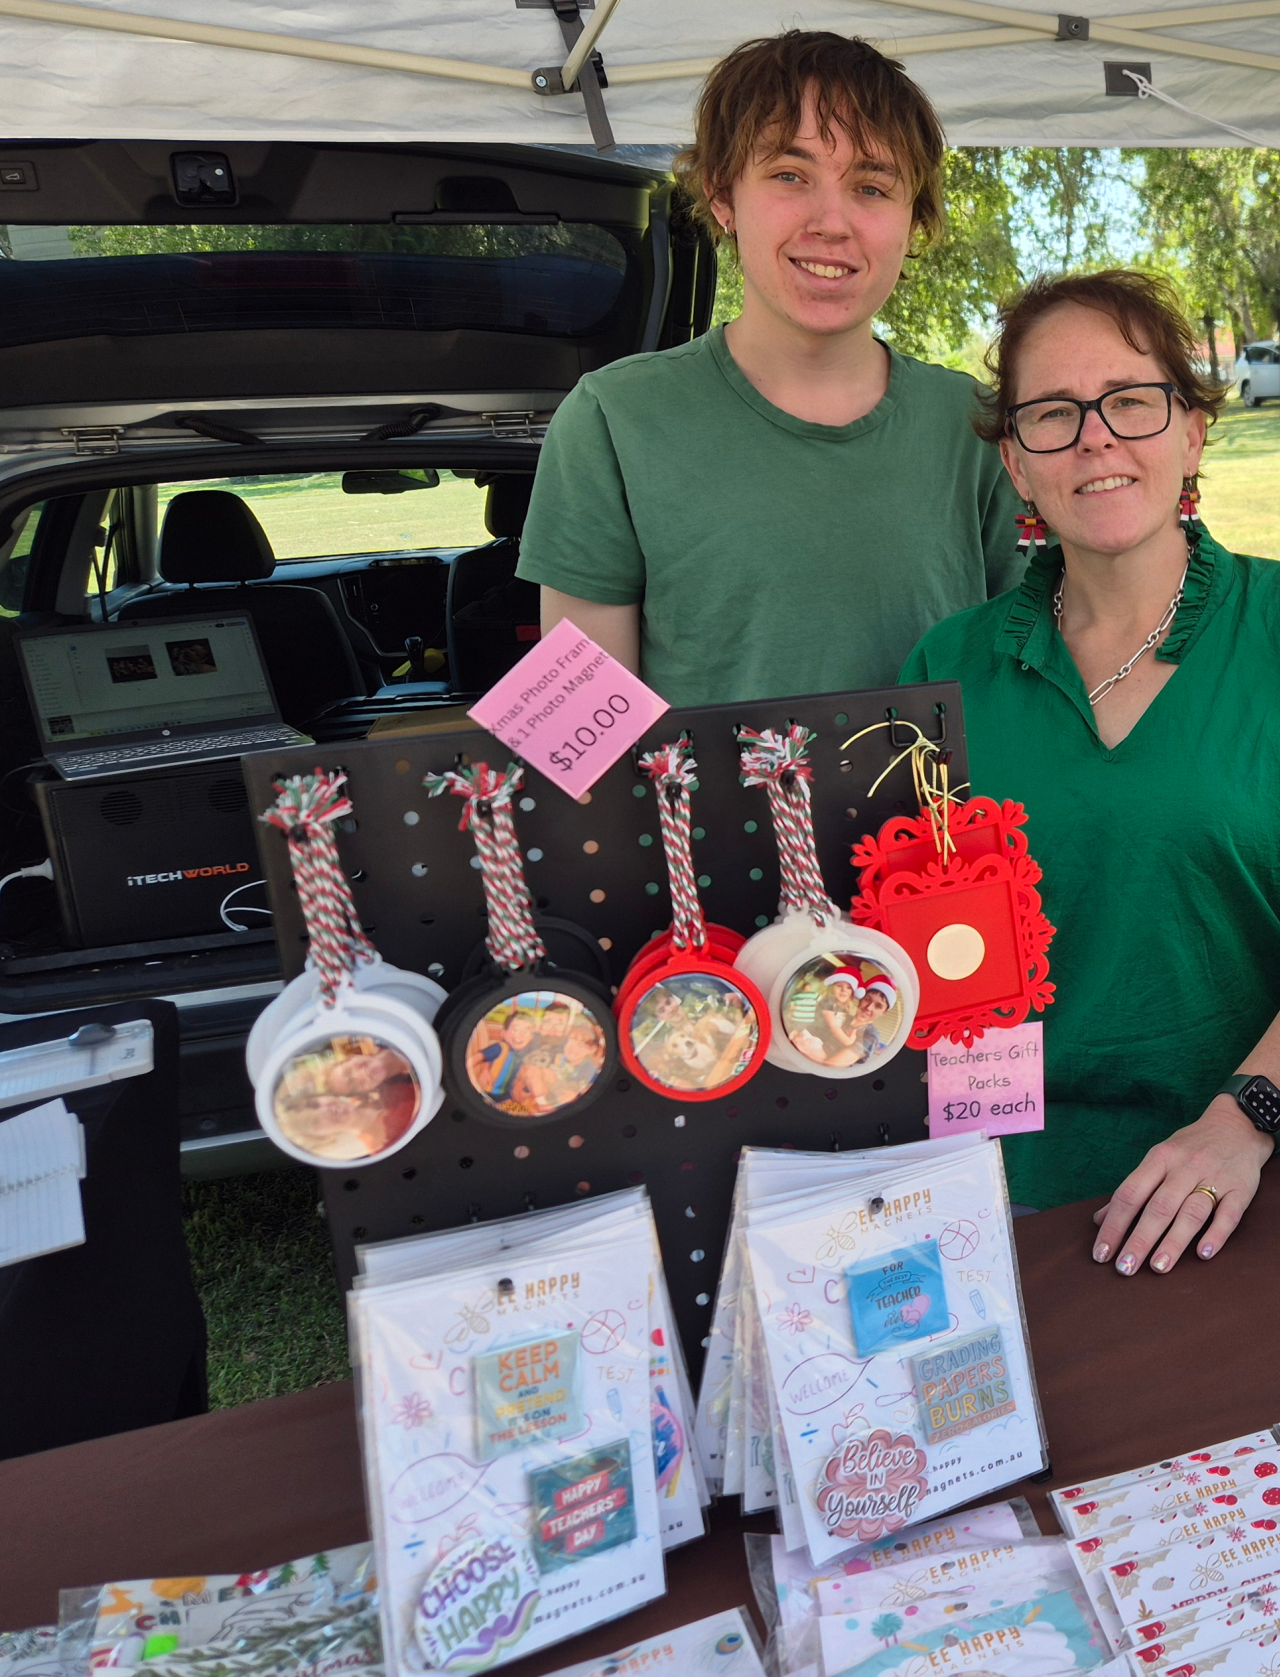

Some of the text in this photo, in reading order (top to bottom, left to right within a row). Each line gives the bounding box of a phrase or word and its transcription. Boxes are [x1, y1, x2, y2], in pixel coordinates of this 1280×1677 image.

[507, 651, 609, 748] & 1 Photo Magnet
[520, 669, 560, 704] Photo
[549, 694, 630, 772] $10.00
[127, 862, 250, 886] iTECHWORLD
[930, 1041, 1039, 1067] Teachers Gift
[968, 1073, 1011, 1091] Packs
[943, 1092, 1035, 1122] $20 each
[883, 1188, 932, 1219] HAPPY
[861, 1205, 933, 1235] MAGNETS
[882, 1261, 903, 1275] FOR
[957, 1270, 993, 1284] TEST
[525, 1272, 580, 1299] HAPPY
[875, 1286, 921, 1310] TEACHER
[498, 1341, 558, 1373] KEEP
[919, 1333, 1001, 1381] GRADING
[500, 1360, 560, 1392] CALM
[597, 1366, 635, 1383] TEST
[789, 1368, 849, 1405] WELCOME
[922, 1356, 1006, 1406] PAPERS
[495, 1388, 567, 1420] PRETEND
[518, 1385, 539, 1399] AND
[928, 1381, 1010, 1430] BURNS
[519, 1413, 568, 1435] LESSON
[932, 1403, 1014, 1442] ZERO CALORIES
[842, 1441, 916, 1473] Believe
[561, 1477, 602, 1504] HAPPY
[869, 1472, 884, 1487] IN
[825, 1484, 921, 1527] Yourself
[1203, 1507, 1246, 1529] HAPPY
[574, 1524, 598, 1546] DAY
[932, 1554, 1015, 1585] MAGNETS
[957, 1545, 1014, 1569] HAPPY
[418, 1541, 516, 1620] CHOOSE
[436, 1566, 520, 1650] HAPPY
[959, 1626, 1021, 1656] HAPPY
